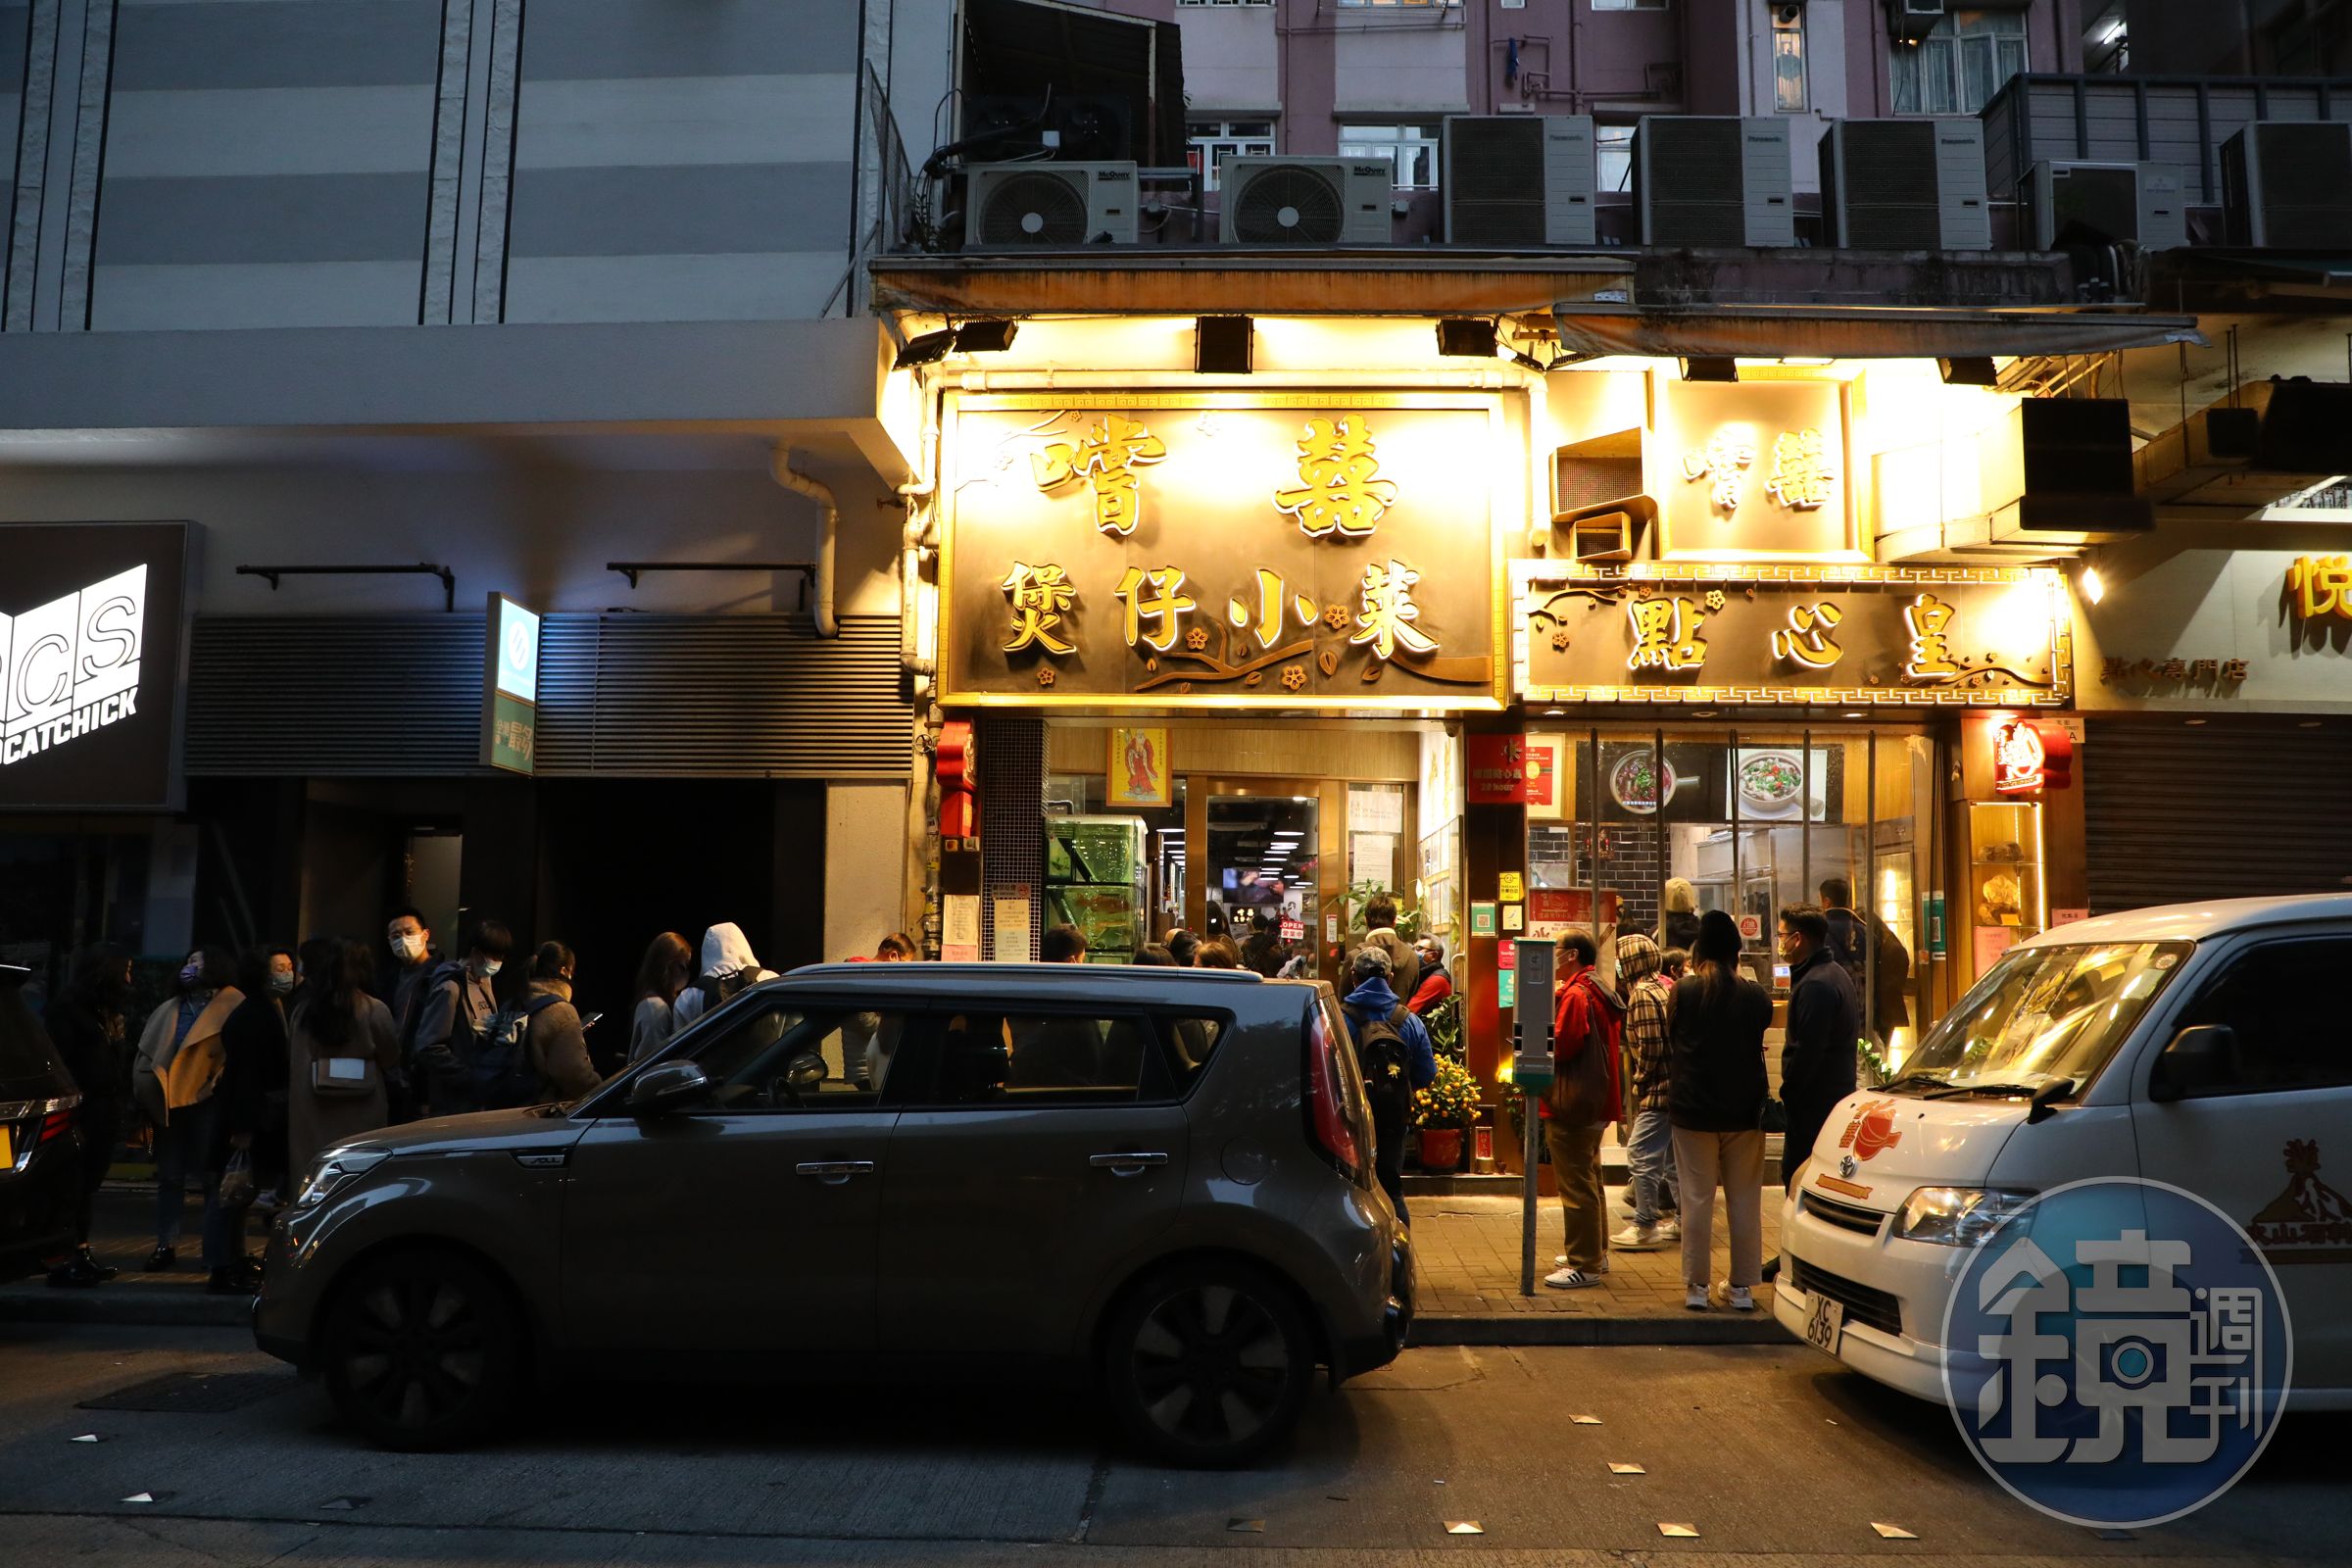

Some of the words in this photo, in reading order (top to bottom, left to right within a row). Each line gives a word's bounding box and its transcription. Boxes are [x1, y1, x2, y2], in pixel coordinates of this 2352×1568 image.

[1001, 560, 1442, 661] 煲仔小菜
[1627, 593, 1961, 679] 點心皇
[0, 686, 139, 765] CATCHICK
[1282, 921, 1303, 930] OPEN
[1807, 1317, 1833, 1348] 6139
[1815, 1295, 1832, 1323] XC
